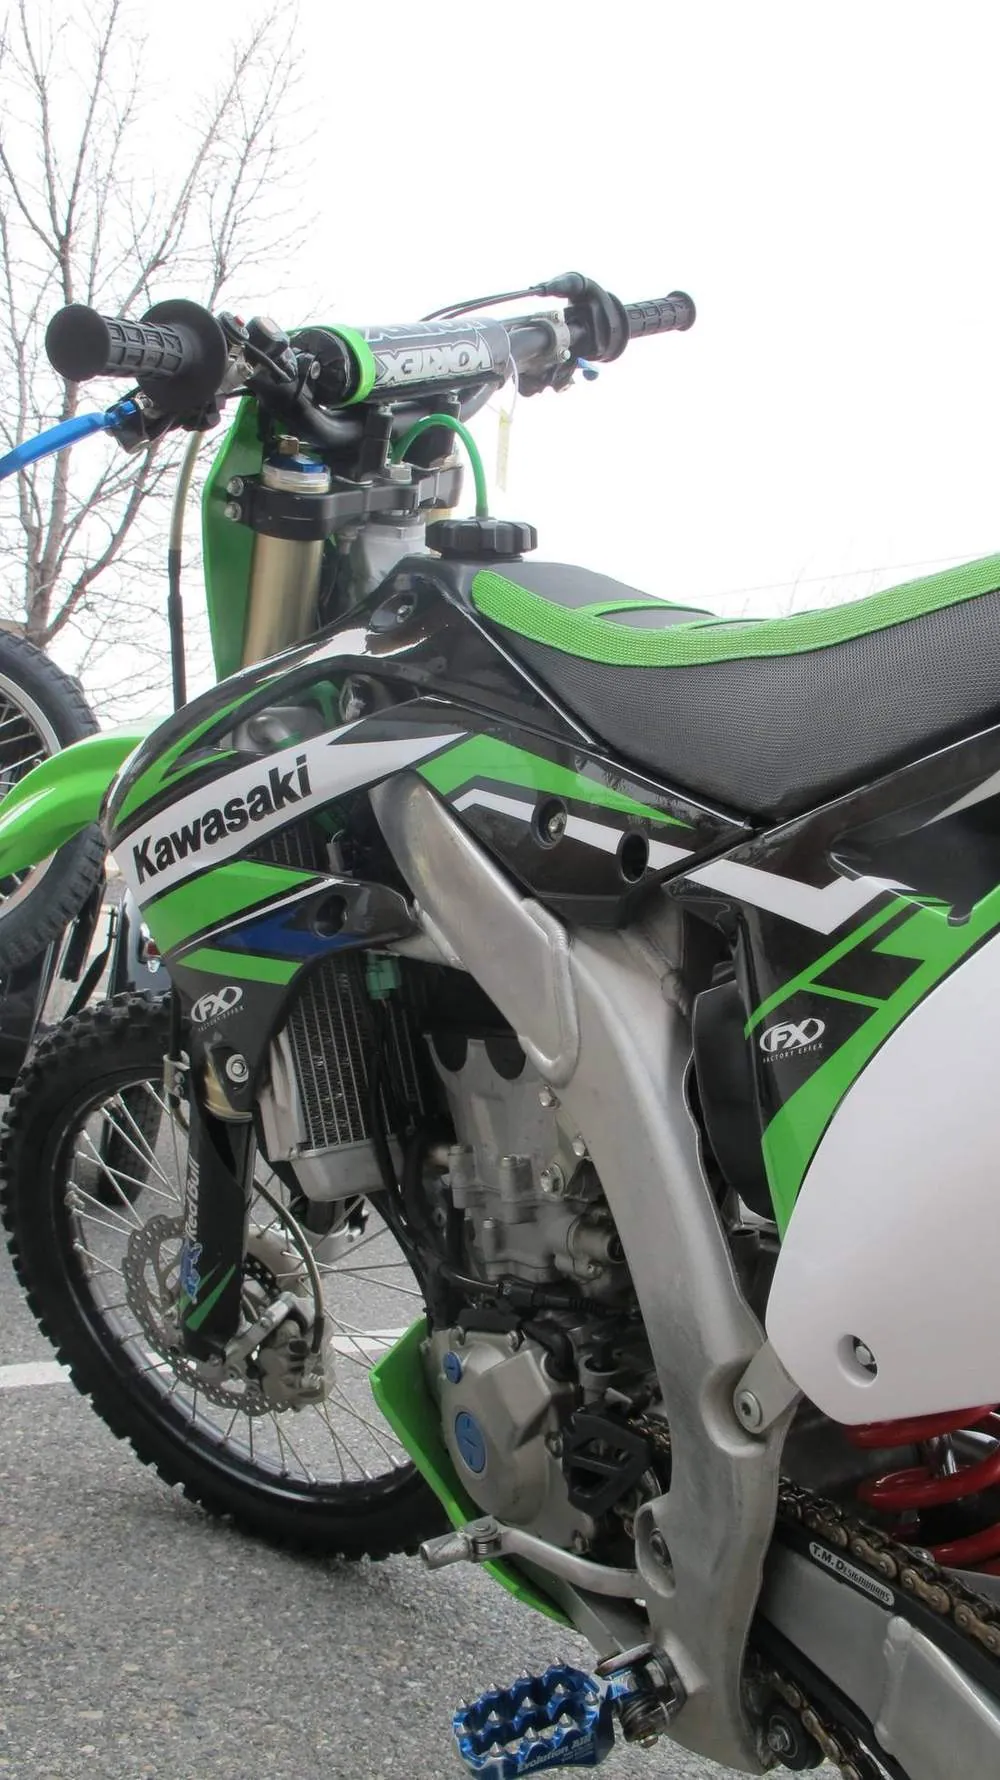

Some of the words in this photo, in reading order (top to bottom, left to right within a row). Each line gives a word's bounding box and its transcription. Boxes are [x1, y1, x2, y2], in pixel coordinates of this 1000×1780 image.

[132, 754, 312, 885] Kawasaki
[196, 987, 236, 1022] FX
[767, 1018, 816, 1052] FX
[187, 1153, 200, 1200] Bull
[185, 1196, 198, 1241] Red
